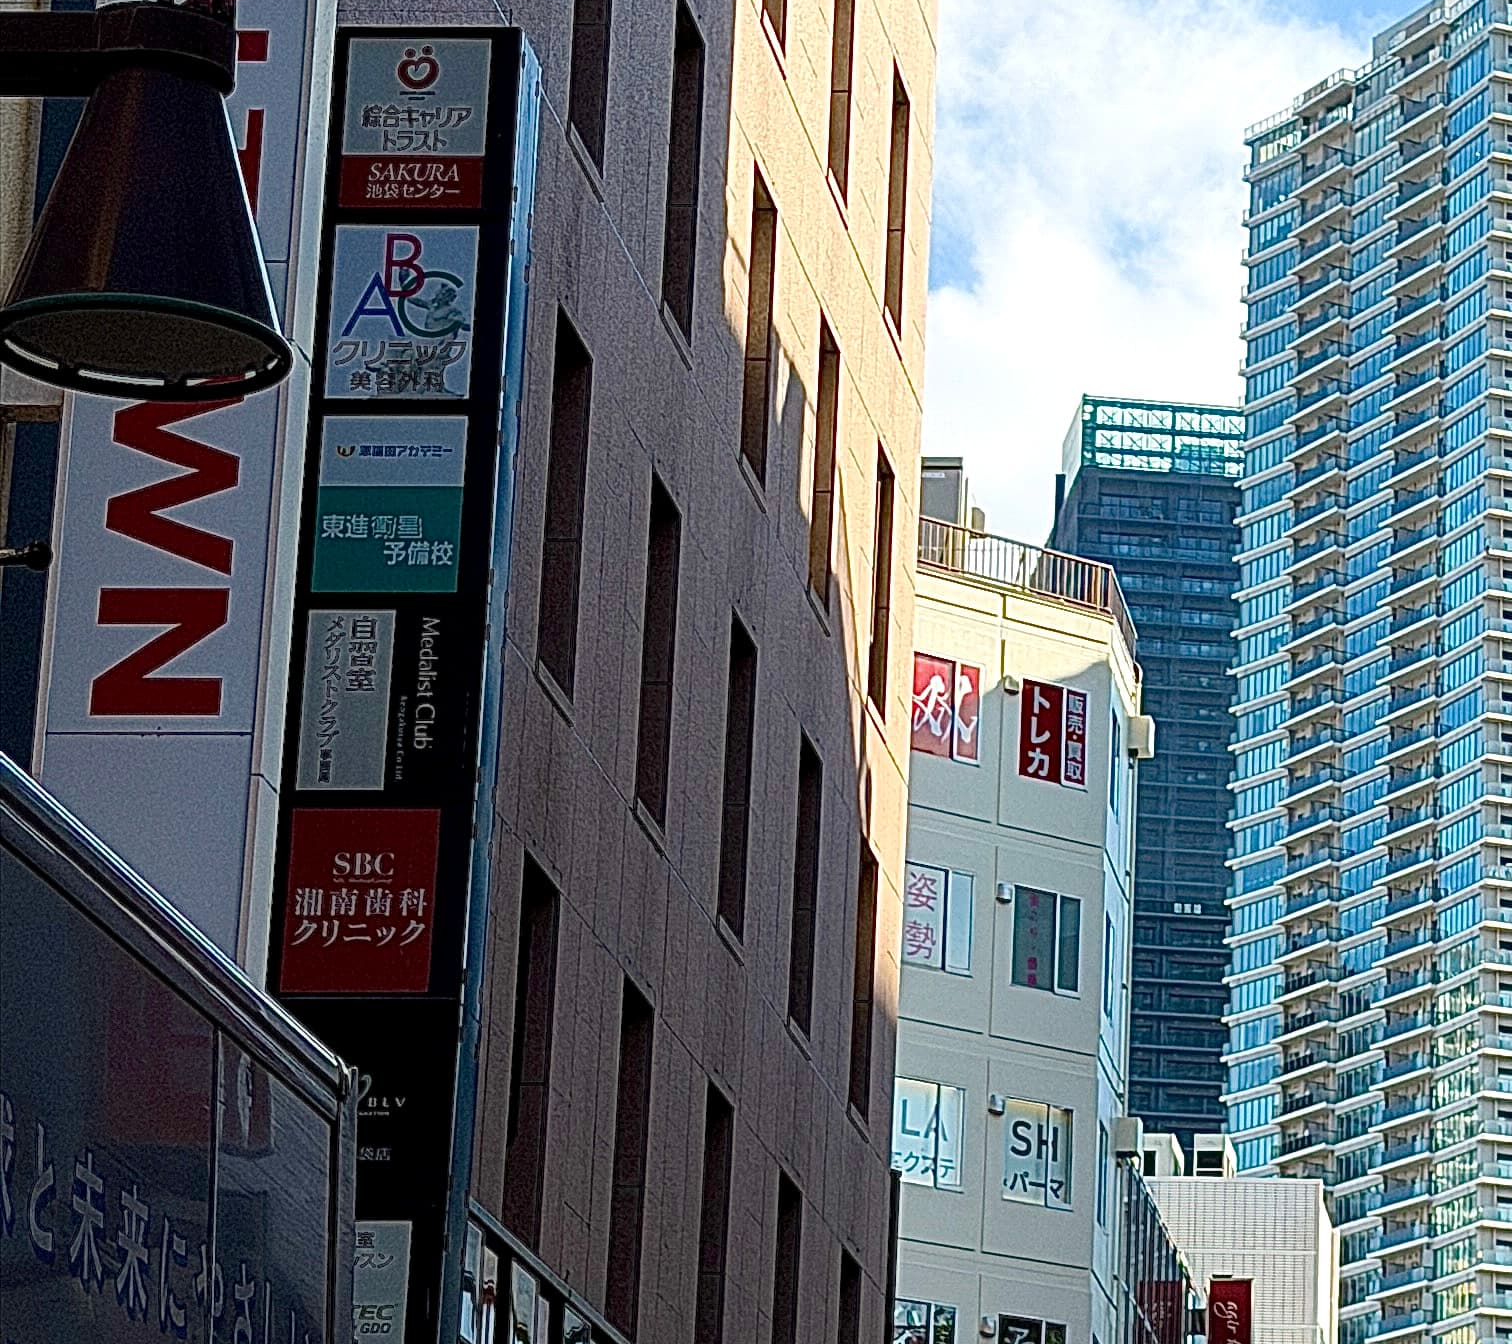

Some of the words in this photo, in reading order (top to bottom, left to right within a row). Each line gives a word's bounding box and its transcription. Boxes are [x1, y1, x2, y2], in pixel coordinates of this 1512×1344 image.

[382, 130, 447, 152] トラスト
[368, 162, 461, 182] SAKURA
[365, 183, 461, 200] 池袋センター
[333, 340, 468, 367] クリニック
[383, 541, 454, 566] 予備校
[415, 616, 441, 698] Medalist
[413, 703, 437, 750] Club
[1027, 686, 1051, 776] トレカ
[332, 852, 395, 877] SBC
[295, 887, 428, 917] 湘南歯科
[905, 871, 938, 960] 姿勢
[291, 919, 426, 948] クリニック
